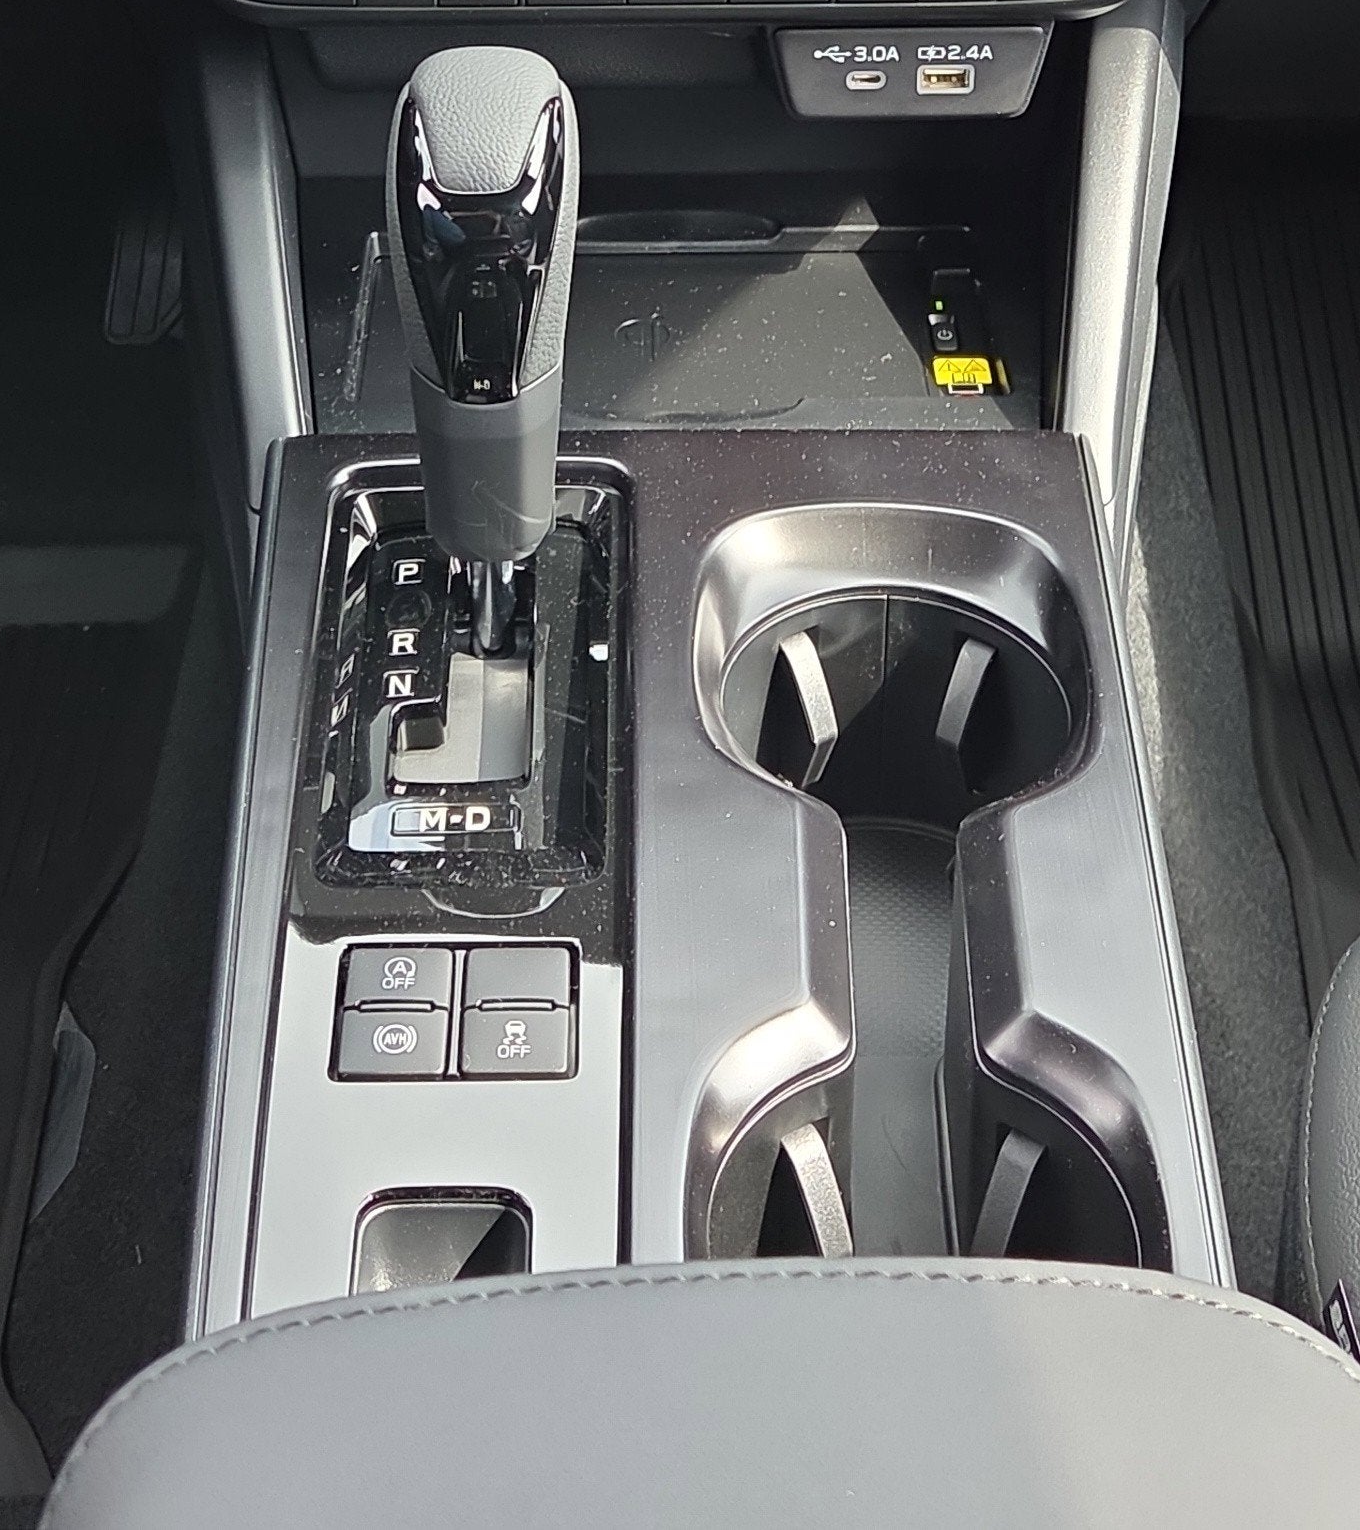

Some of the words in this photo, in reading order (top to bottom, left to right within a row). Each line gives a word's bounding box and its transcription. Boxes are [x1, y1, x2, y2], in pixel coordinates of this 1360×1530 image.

[853, 46, 900, 63] 3.0A
[946, 45, 994, 62] 2.4A
[398, 563, 420, 582] P
[393, 634, 417, 654] R
[388, 675, 413, 697] N
[382, 978, 416, 990] OFF
[383, 1032, 408, 1045] AVH
[497, 1044, 532, 1058] OFF
